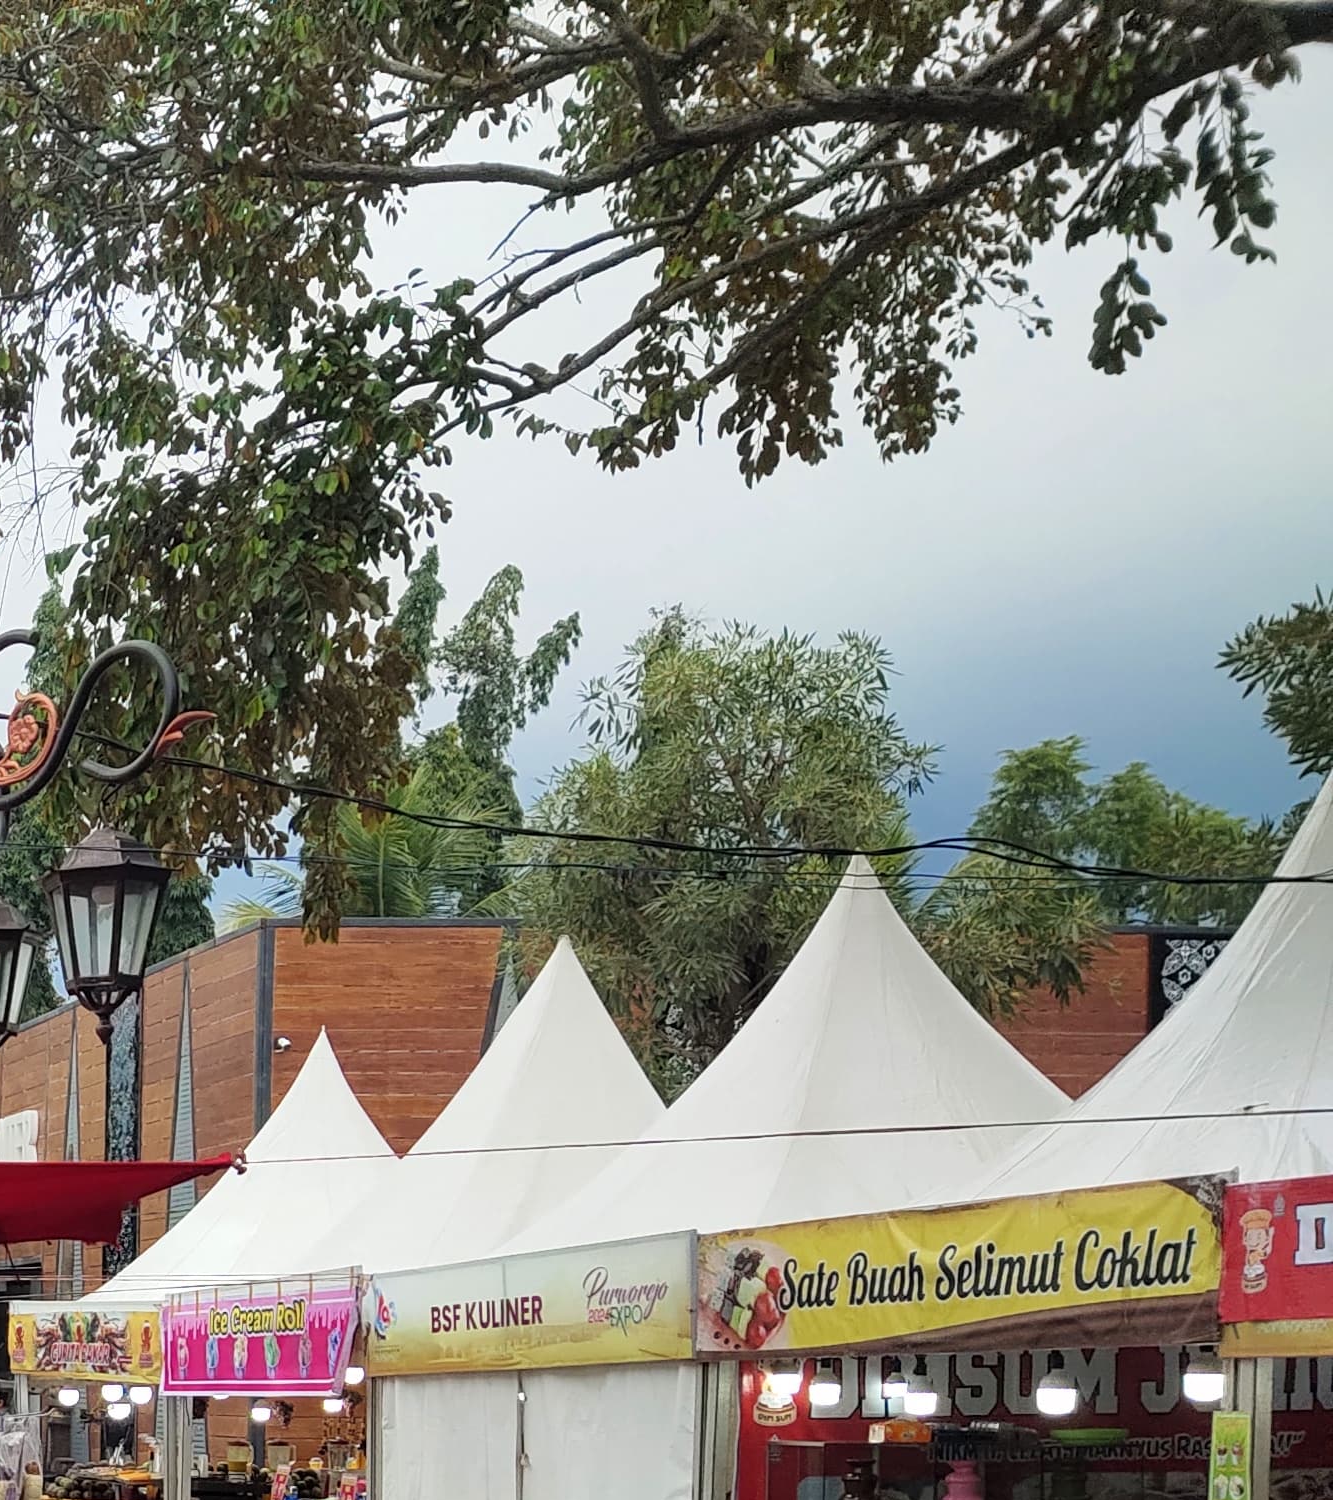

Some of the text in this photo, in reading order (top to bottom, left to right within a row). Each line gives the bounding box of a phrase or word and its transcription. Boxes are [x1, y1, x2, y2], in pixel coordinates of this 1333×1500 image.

[776, 1226, 1198, 1312] Sate Buah Selimut Coklat
[209, 1298, 306, 1337] Ice Cream Roll
[430, 1295, 544, 1334] BSF KULINER
